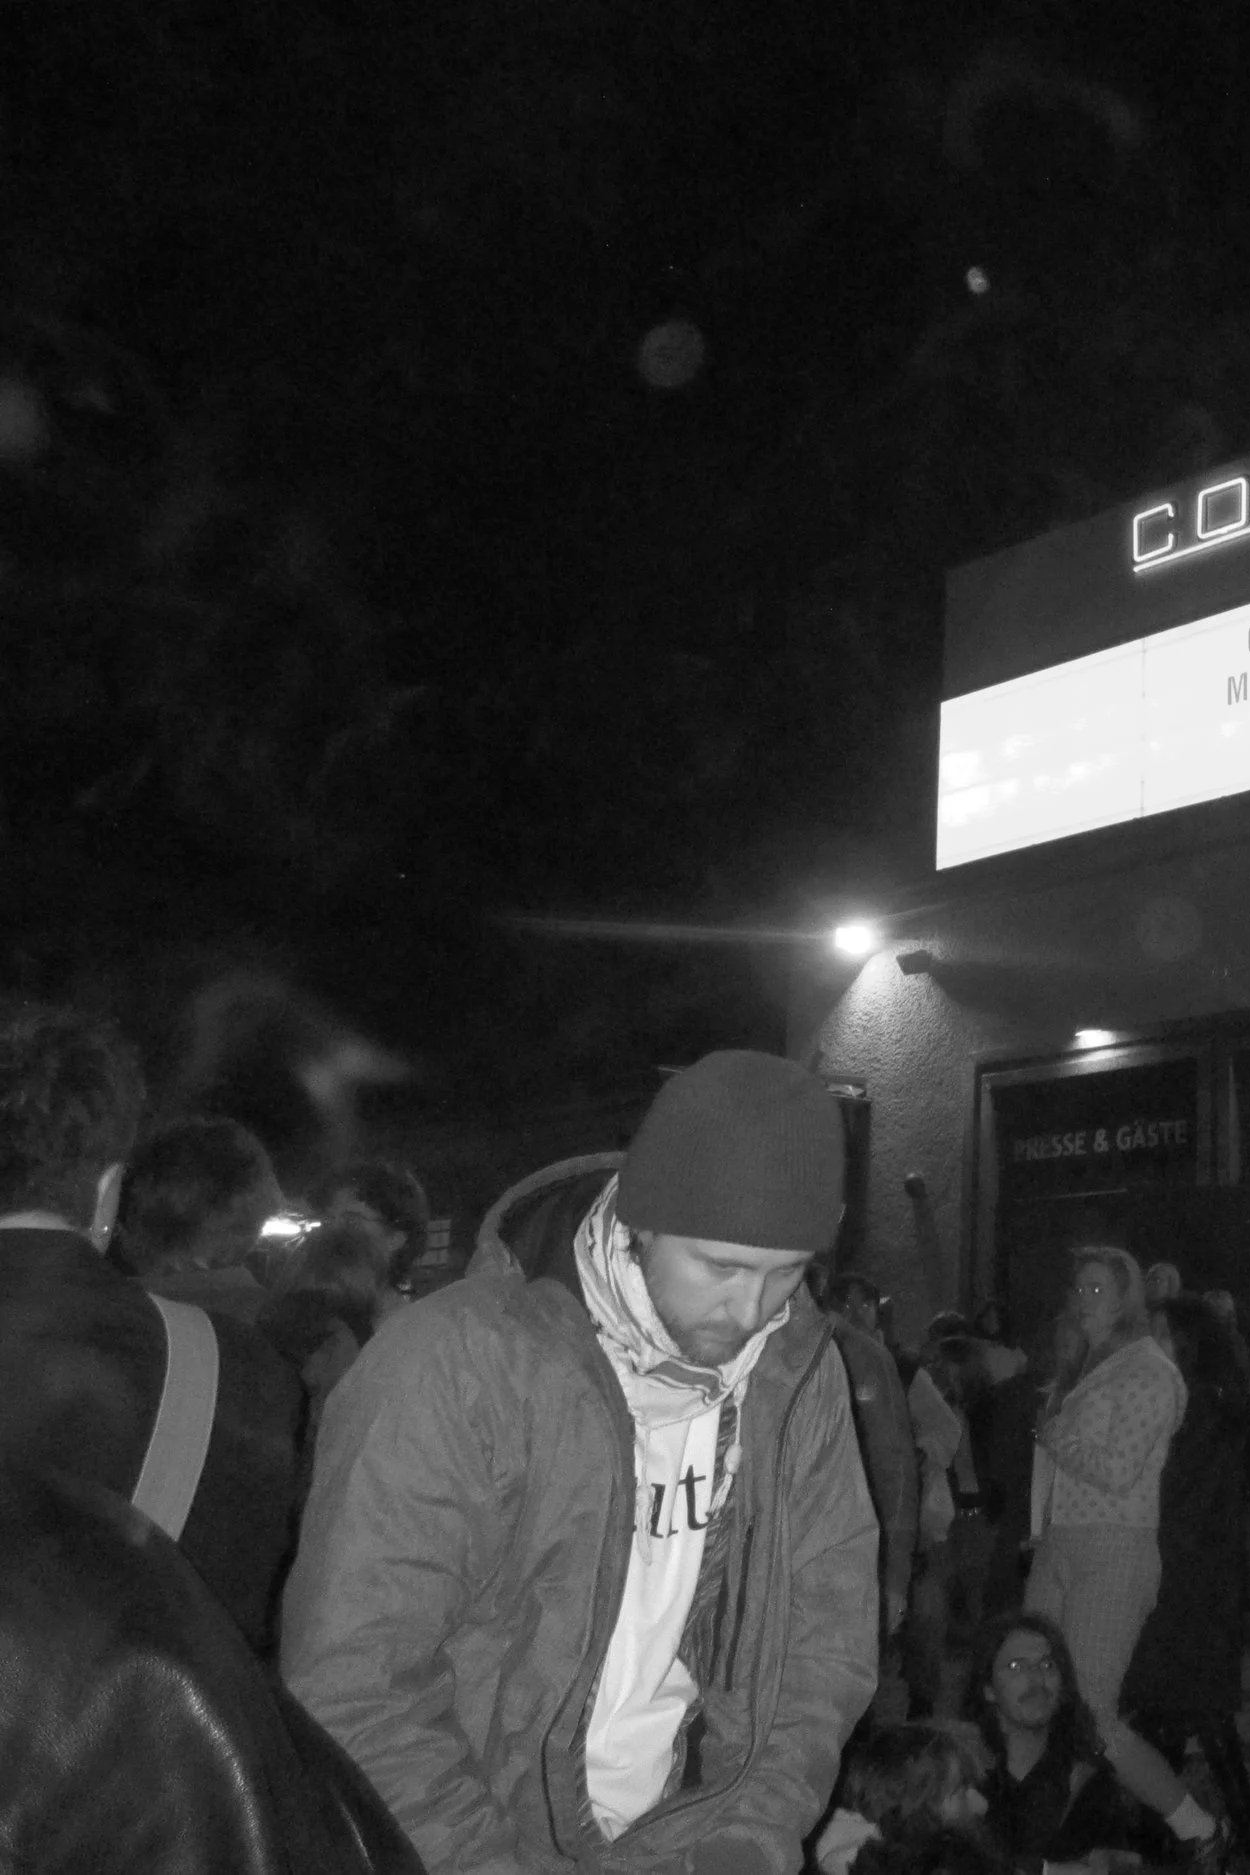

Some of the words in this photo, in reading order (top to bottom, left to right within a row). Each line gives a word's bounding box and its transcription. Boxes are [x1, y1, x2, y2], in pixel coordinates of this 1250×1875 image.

[1013, 1131, 1088, 1162] PRESSE
[1093, 1128, 1110, 1153] &
[1115, 1119, 1188, 1151] GÄSTE
